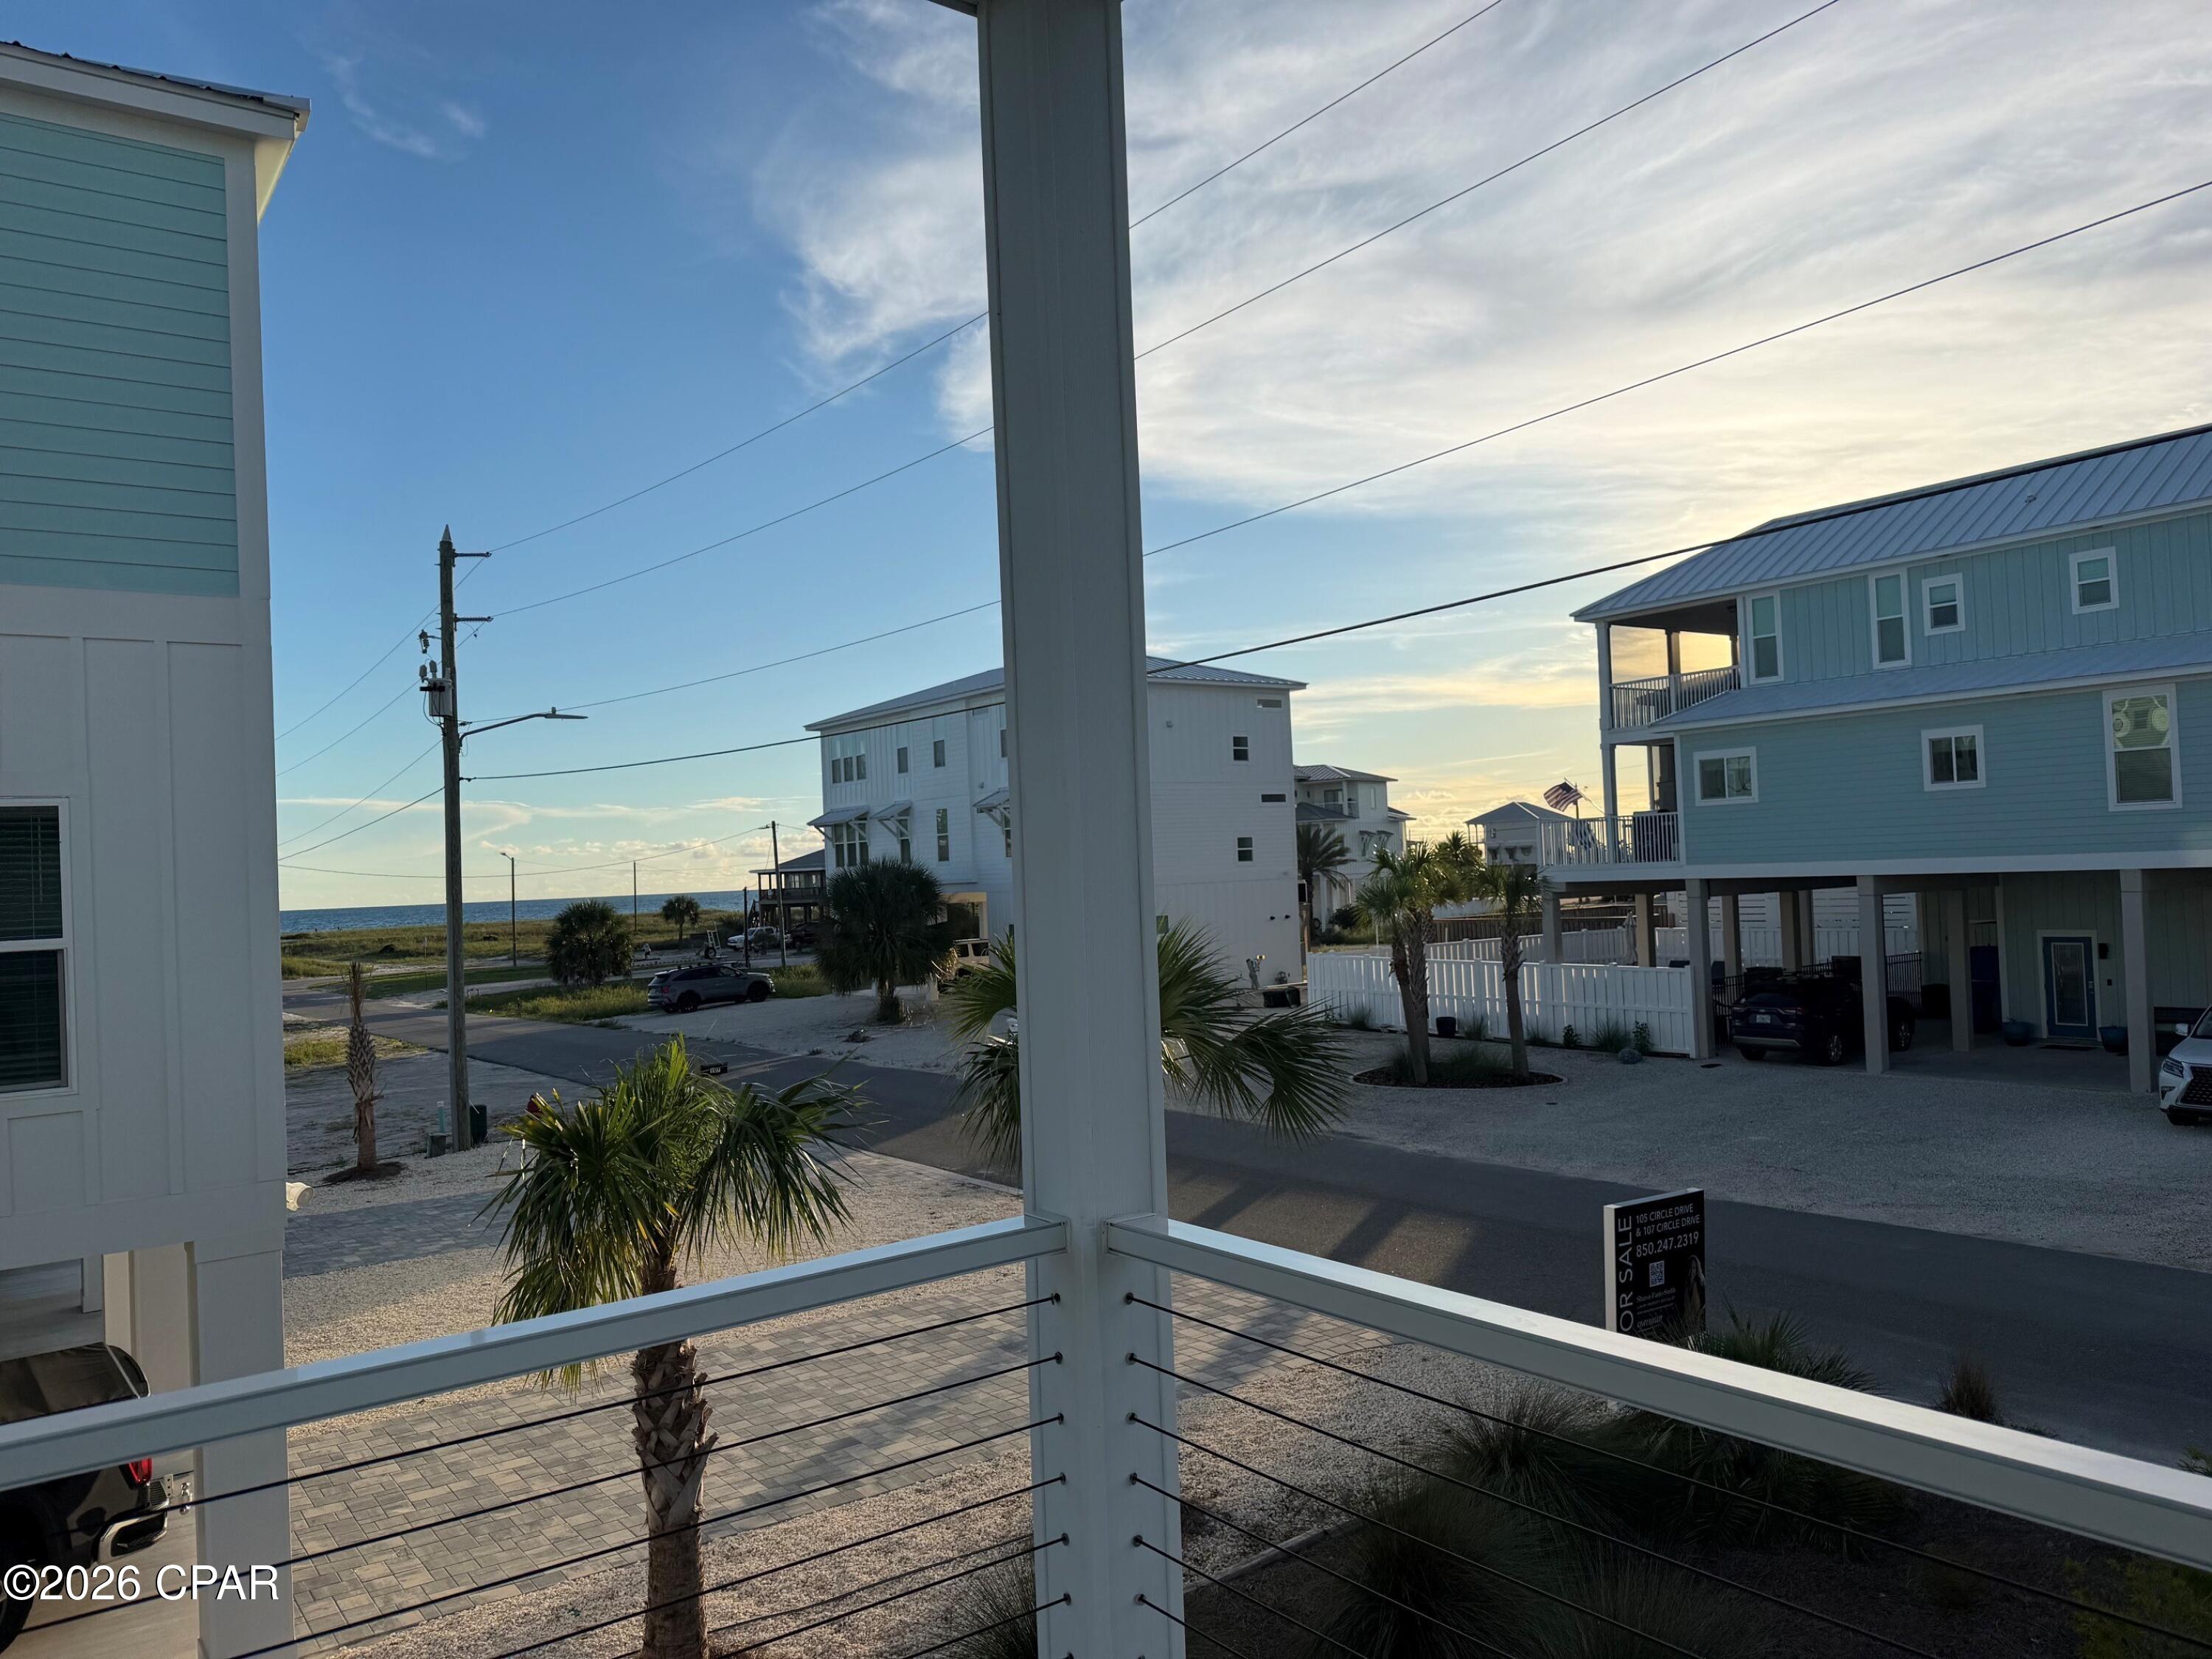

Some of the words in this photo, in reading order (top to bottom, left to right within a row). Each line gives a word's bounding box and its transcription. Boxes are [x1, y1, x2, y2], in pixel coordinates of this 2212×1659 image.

[1635, 1228, 1641, 1237] &
[1644, 1225, 1655, 1235] 107
[1656, 1219, 1680, 1232] CIRCLE
[1681, 1214, 1700, 1227] DRIVE
[1636, 1214, 1648, 1224] 105
[1649, 1208, 1674, 1221] CIRCLE
[1674, 1203, 1694, 1216] DRIVE
[1618, 1215, 1633, 1284] SALE
[1636, 1231, 1700, 1257] 850.247.2319
[1619, 1291, 1634, 1332] OR
